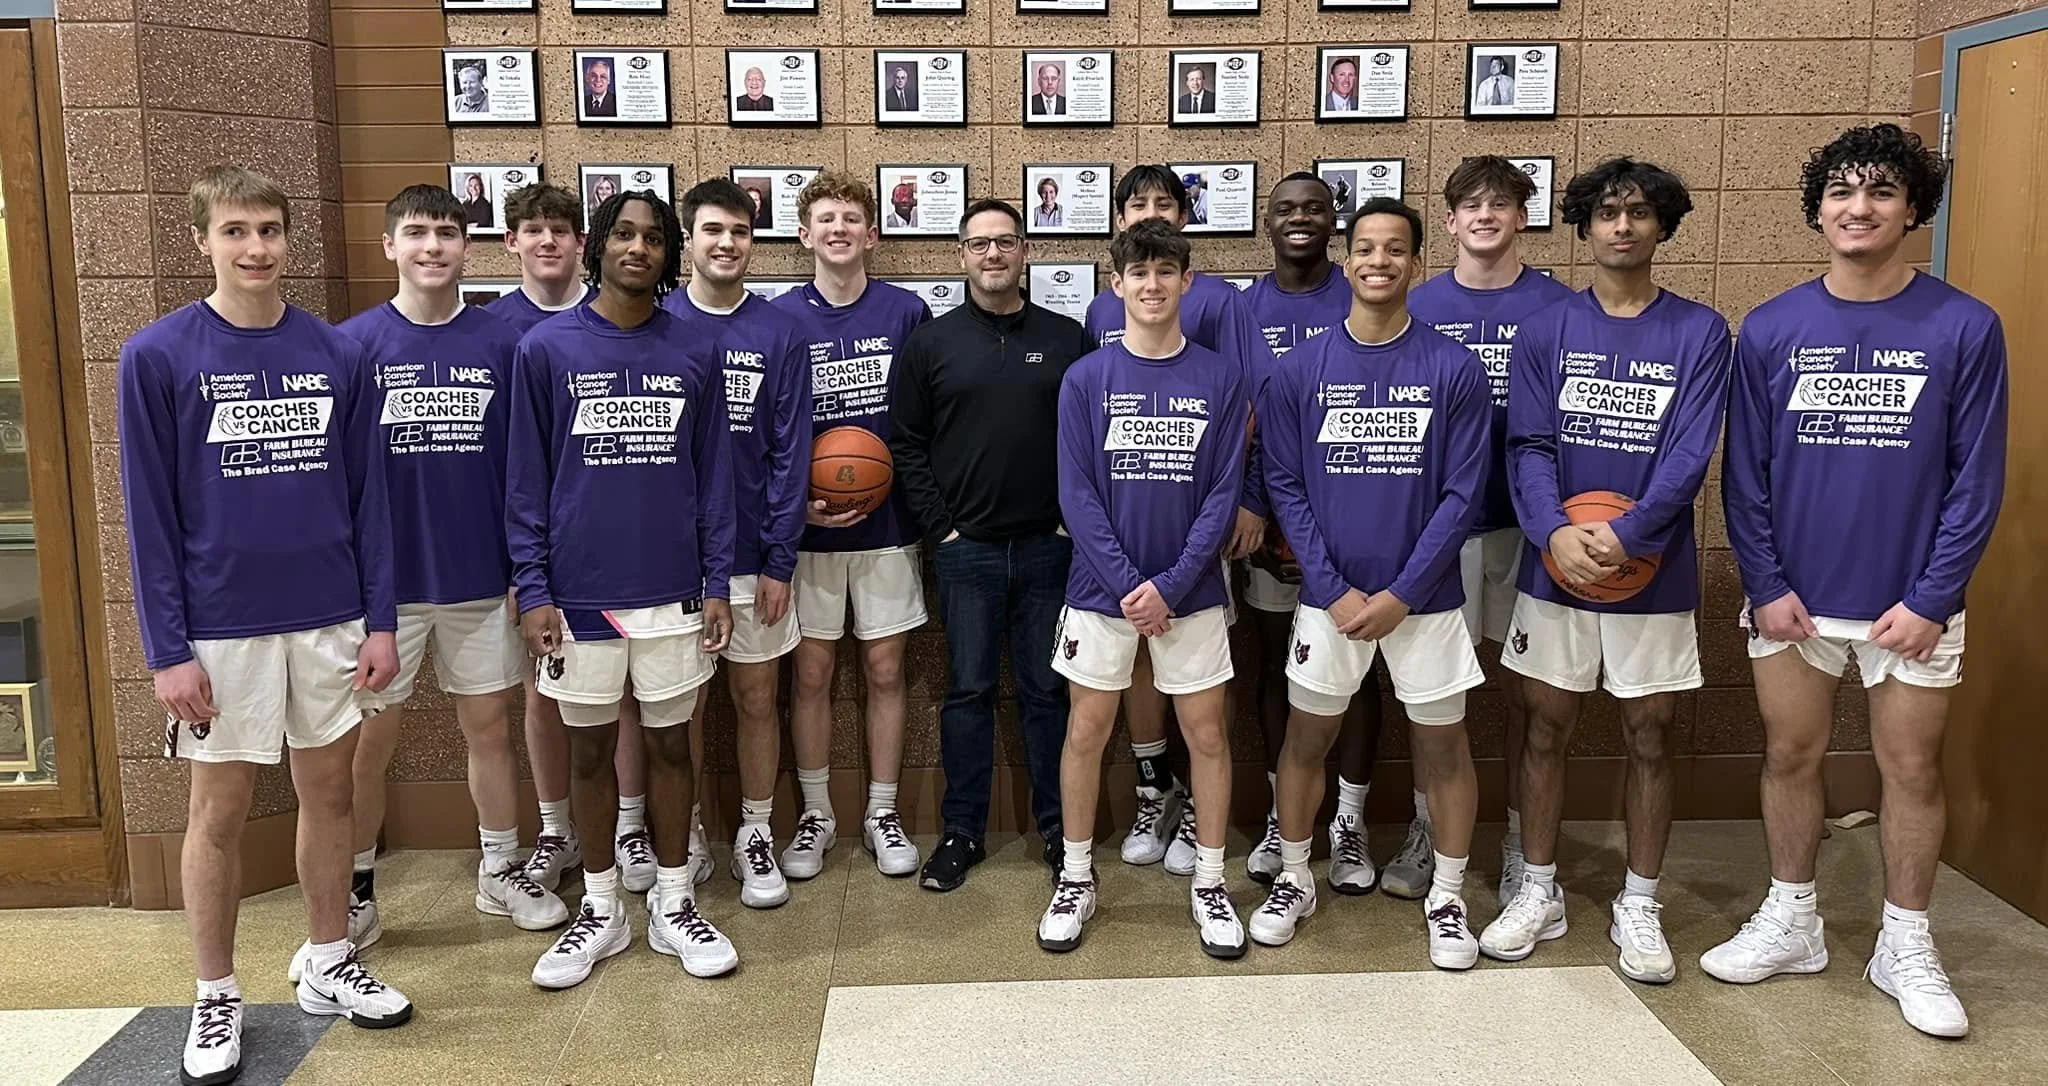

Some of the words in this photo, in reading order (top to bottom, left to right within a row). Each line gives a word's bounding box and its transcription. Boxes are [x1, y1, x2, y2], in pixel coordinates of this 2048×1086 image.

[1567, 352, 1606, 361] American
[1799, 347, 1846, 355] American
[384, 363, 425, 372] American
[816, 360, 880, 377] COACHES
[210, 372, 255, 383] American
[384, 371, 416, 379] Cancer
[576, 372, 617, 381] American
[828, 371, 882, 388] CANCER
[211, 383, 246, 391] Cancer
[1327, 383, 1366, 391] American
[1814, 378, 1905, 392] COACHES
[839, 391, 859, 400] FARM
[1110, 393, 1146, 401] American
[1326, 391, 1356, 399] Cancer
[1577, 382, 1656, 401] COACHES
[401, 391, 479, 404] COACHES
[1828, 393, 1905, 407] CANCER
[232, 402, 318, 419] COACHES
[415, 405, 480, 417] CANCER
[594, 401, 671, 414] COACHES
[1587, 397, 1655, 416] CANCER
[607, 415, 672, 428] CANCER
[1340, 412, 1417, 424] COACHES
[1596, 418, 1620, 428] FARM
[1839, 414, 1865, 423] FARM
[248, 417, 320, 434] CANCER
[1123, 420, 1194, 433] COACHES
[1352, 426, 1417, 438] CANCER
[620, 435, 643, 443] FARM
[1133, 434, 1194, 447] CANCER
[1561, 434, 1574, 443] The
[1576, 437, 1595, 446] Brad
[1597, 440, 1619, 449] Case
[1621, 443, 1656, 454] Agency
[1797, 435, 1814, 443] The
[1817, 436, 1839, 444] Brad
[1842, 437, 1867, 445] Case
[1869, 438, 1910, 448] Agency
[264, 440, 289, 450] FARM
[391, 446, 407, 454] The
[409, 445, 429, 453] Brad
[455, 444, 484, 453] Agency
[1362, 445, 1385, 453] FARM
[602, 457, 623, 465] Brad
[650, 456, 676, 464] Agency
[222, 468, 242, 477] The
[245, 466, 269, 475] Brad
[271, 464, 296, 472] Case
[298, 462, 328, 471] Agency
[1326, 466, 1341, 474] The
[1390, 466, 1423, 475] Agency
